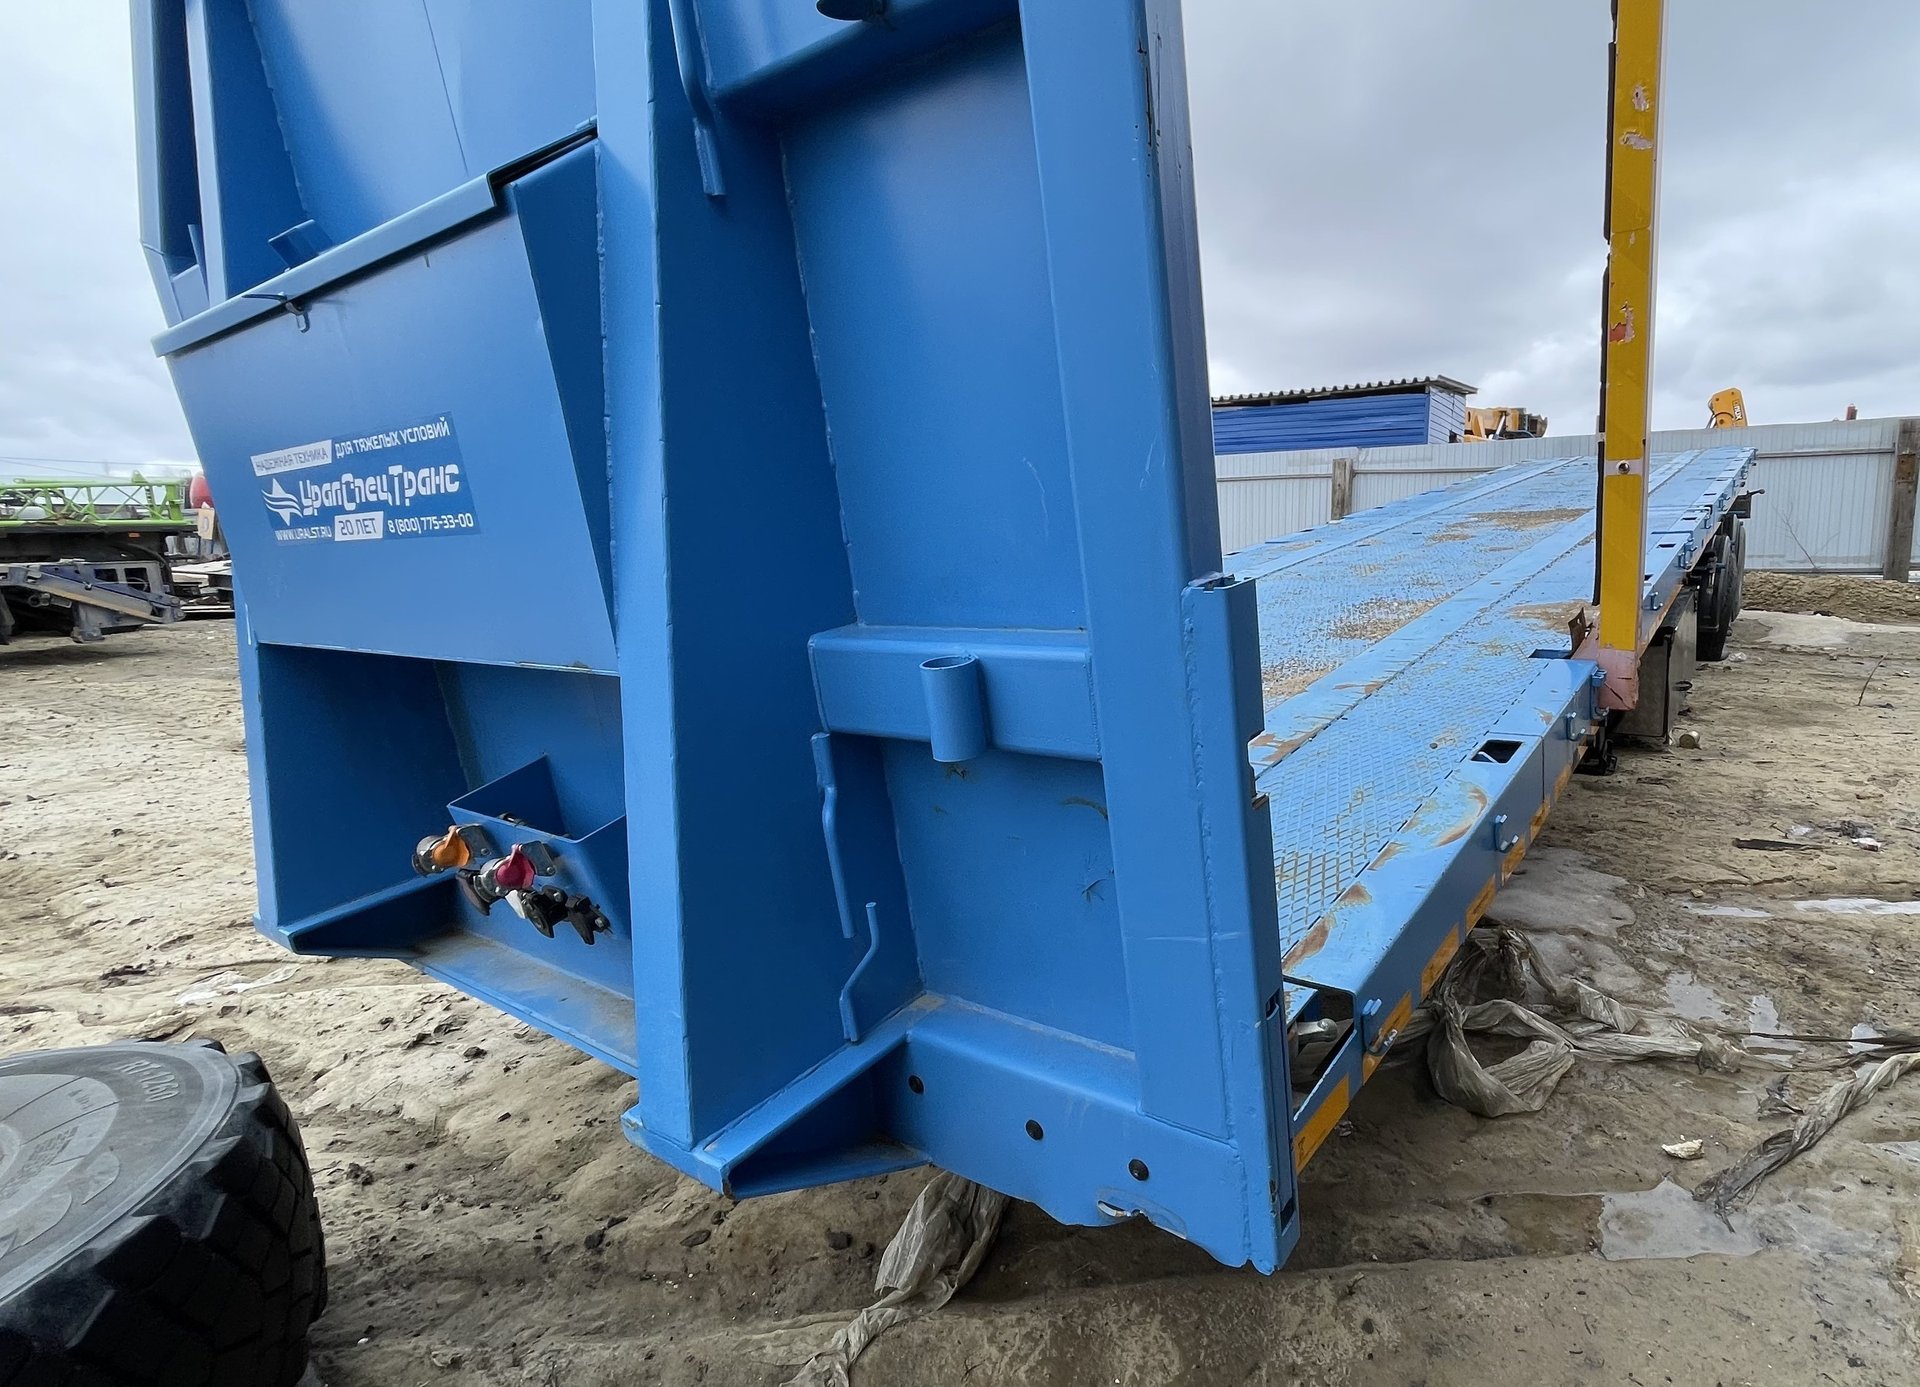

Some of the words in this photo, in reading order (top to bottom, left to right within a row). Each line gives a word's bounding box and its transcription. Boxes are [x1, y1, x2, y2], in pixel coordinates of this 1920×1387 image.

[335, 440, 354, 459] ДЛЯ
[353, 431, 401, 453] ТЯЖЕЛЫХ
[399, 416, 450, 444] УСЛОВИЙ
[293, 447, 329, 464] ТЕХНИКА
[338, 520, 354, 536] 20
[356, 518, 377, 534] ЛЕТ
[387, 520, 396, 533] 8
[395, 517, 422, 535] (800)
[420, 512, 474, 530] 775-33-00
